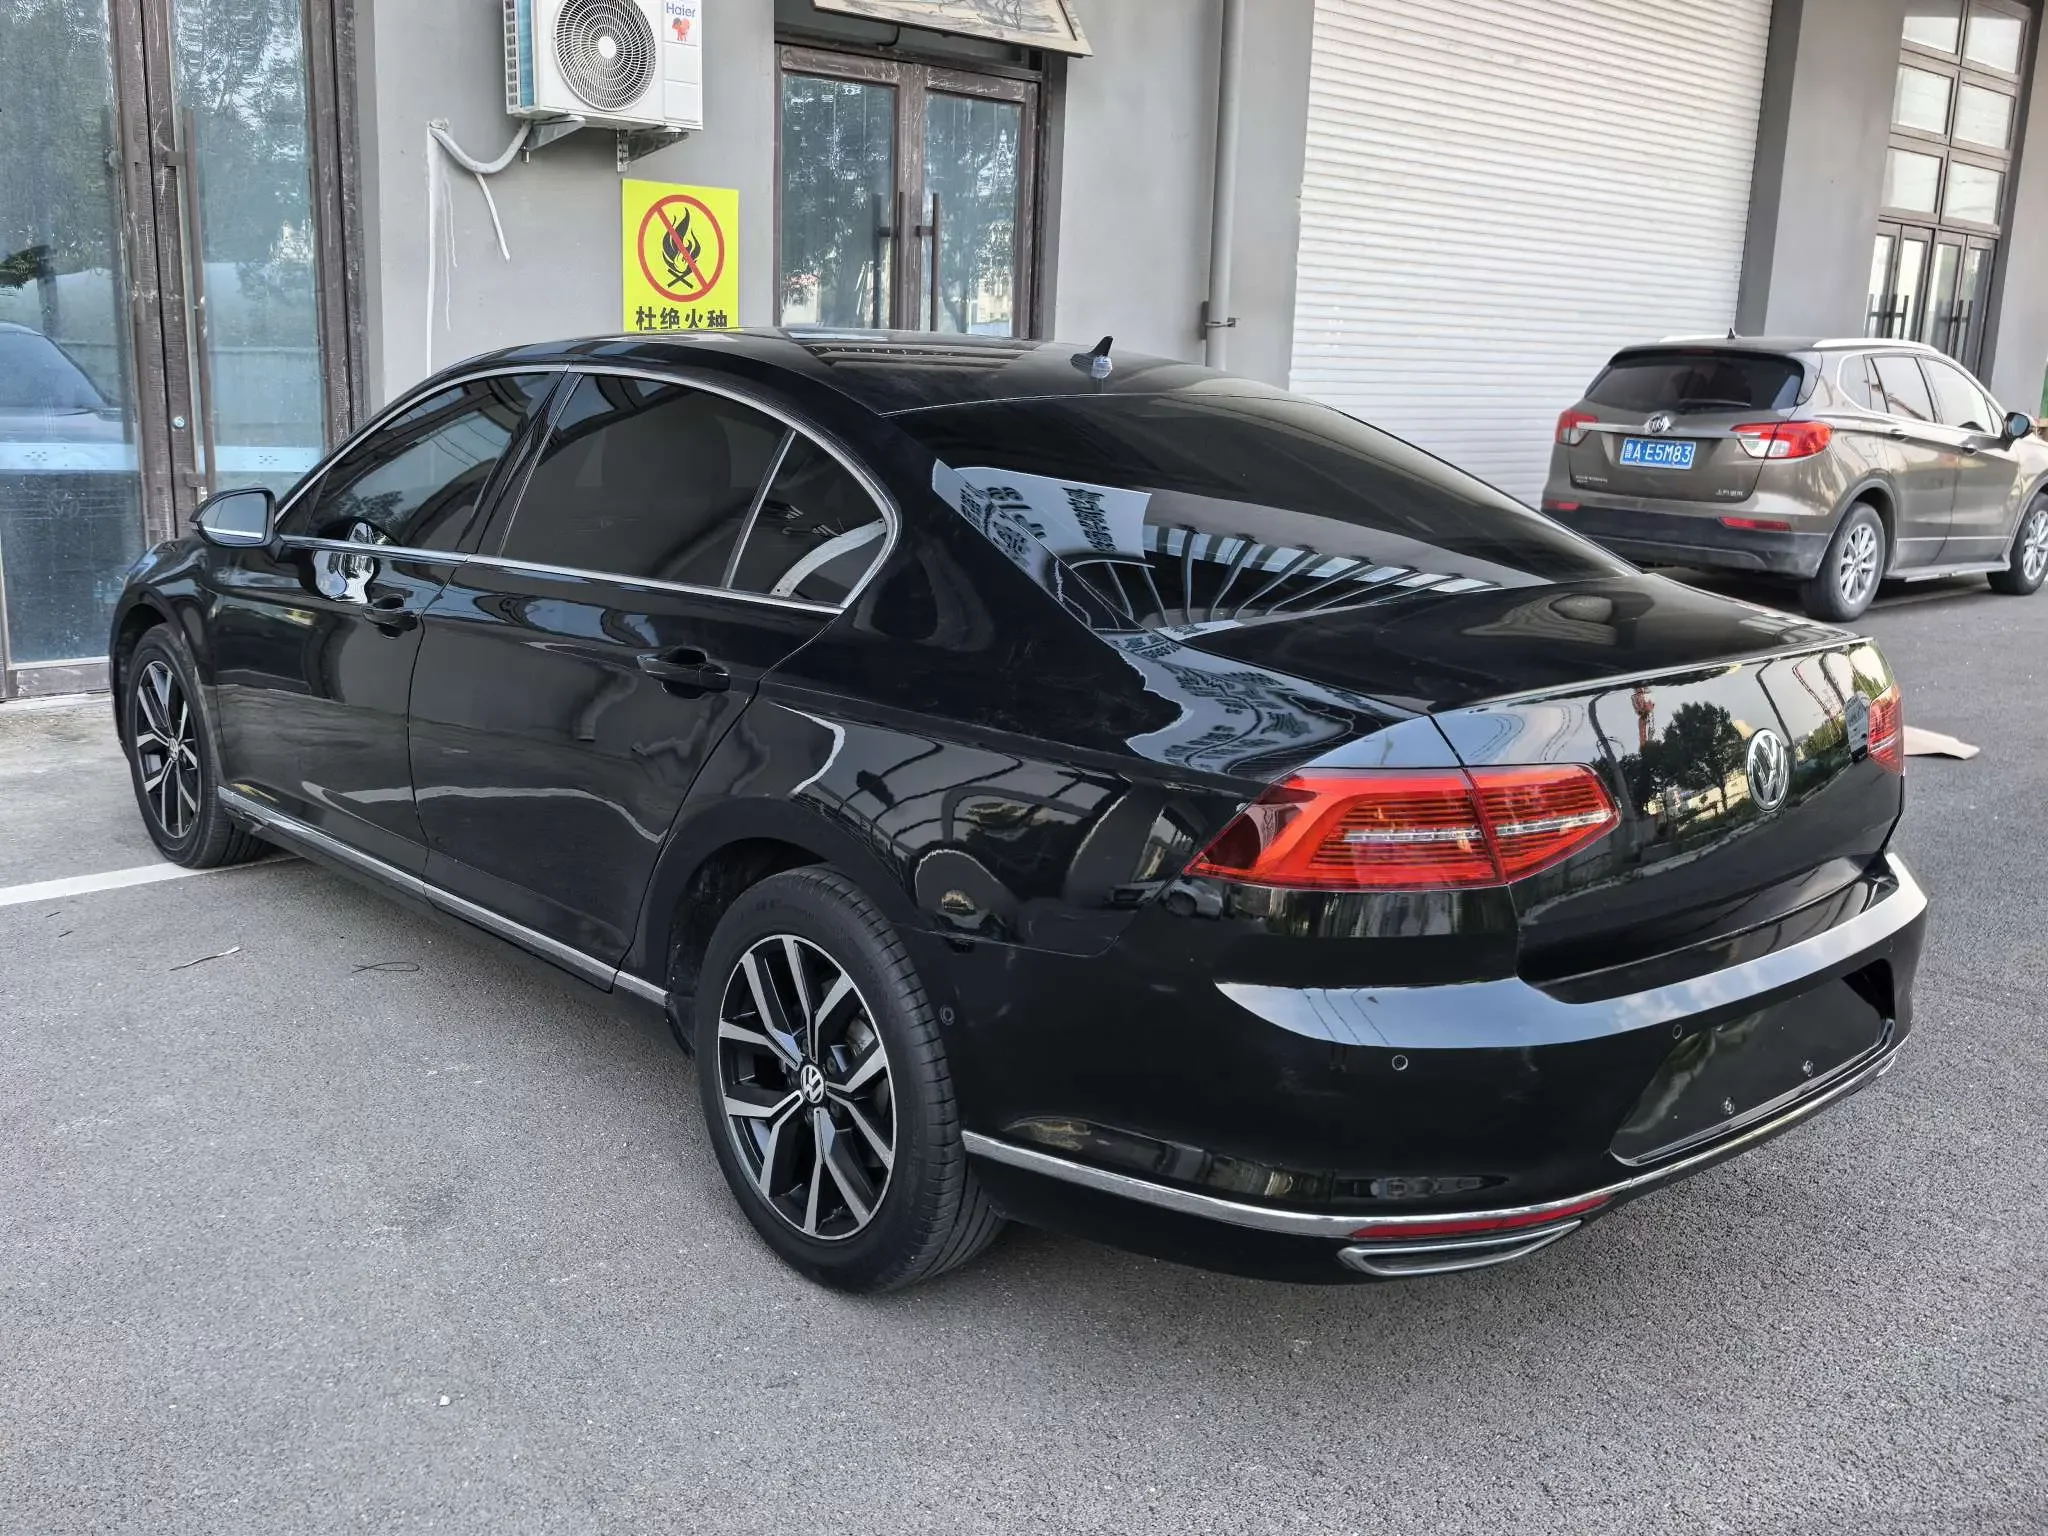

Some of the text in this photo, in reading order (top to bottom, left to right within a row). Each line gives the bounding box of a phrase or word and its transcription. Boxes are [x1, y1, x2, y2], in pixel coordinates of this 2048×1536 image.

[666, 2, 696, 19] Haier
[635, 305, 728, 331] 杜绝火种
